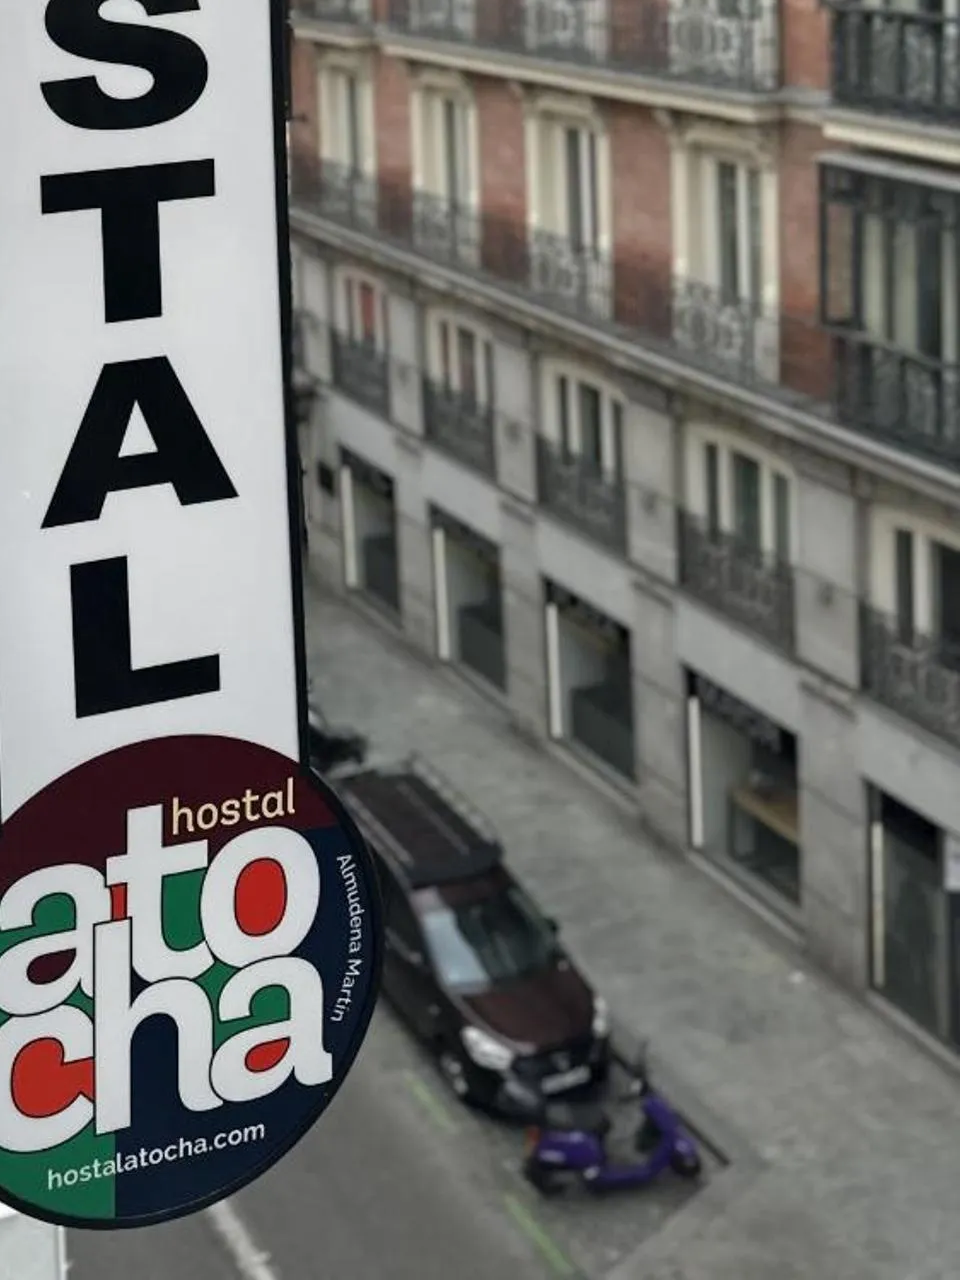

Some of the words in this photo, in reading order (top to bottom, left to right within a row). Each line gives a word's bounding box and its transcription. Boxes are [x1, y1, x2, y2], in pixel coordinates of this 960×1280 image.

[172, 776, 296, 836] hostal
[336, 853, 365, 954] Almudena
[47, 1123, 265, 1191] hostalatocha.com
